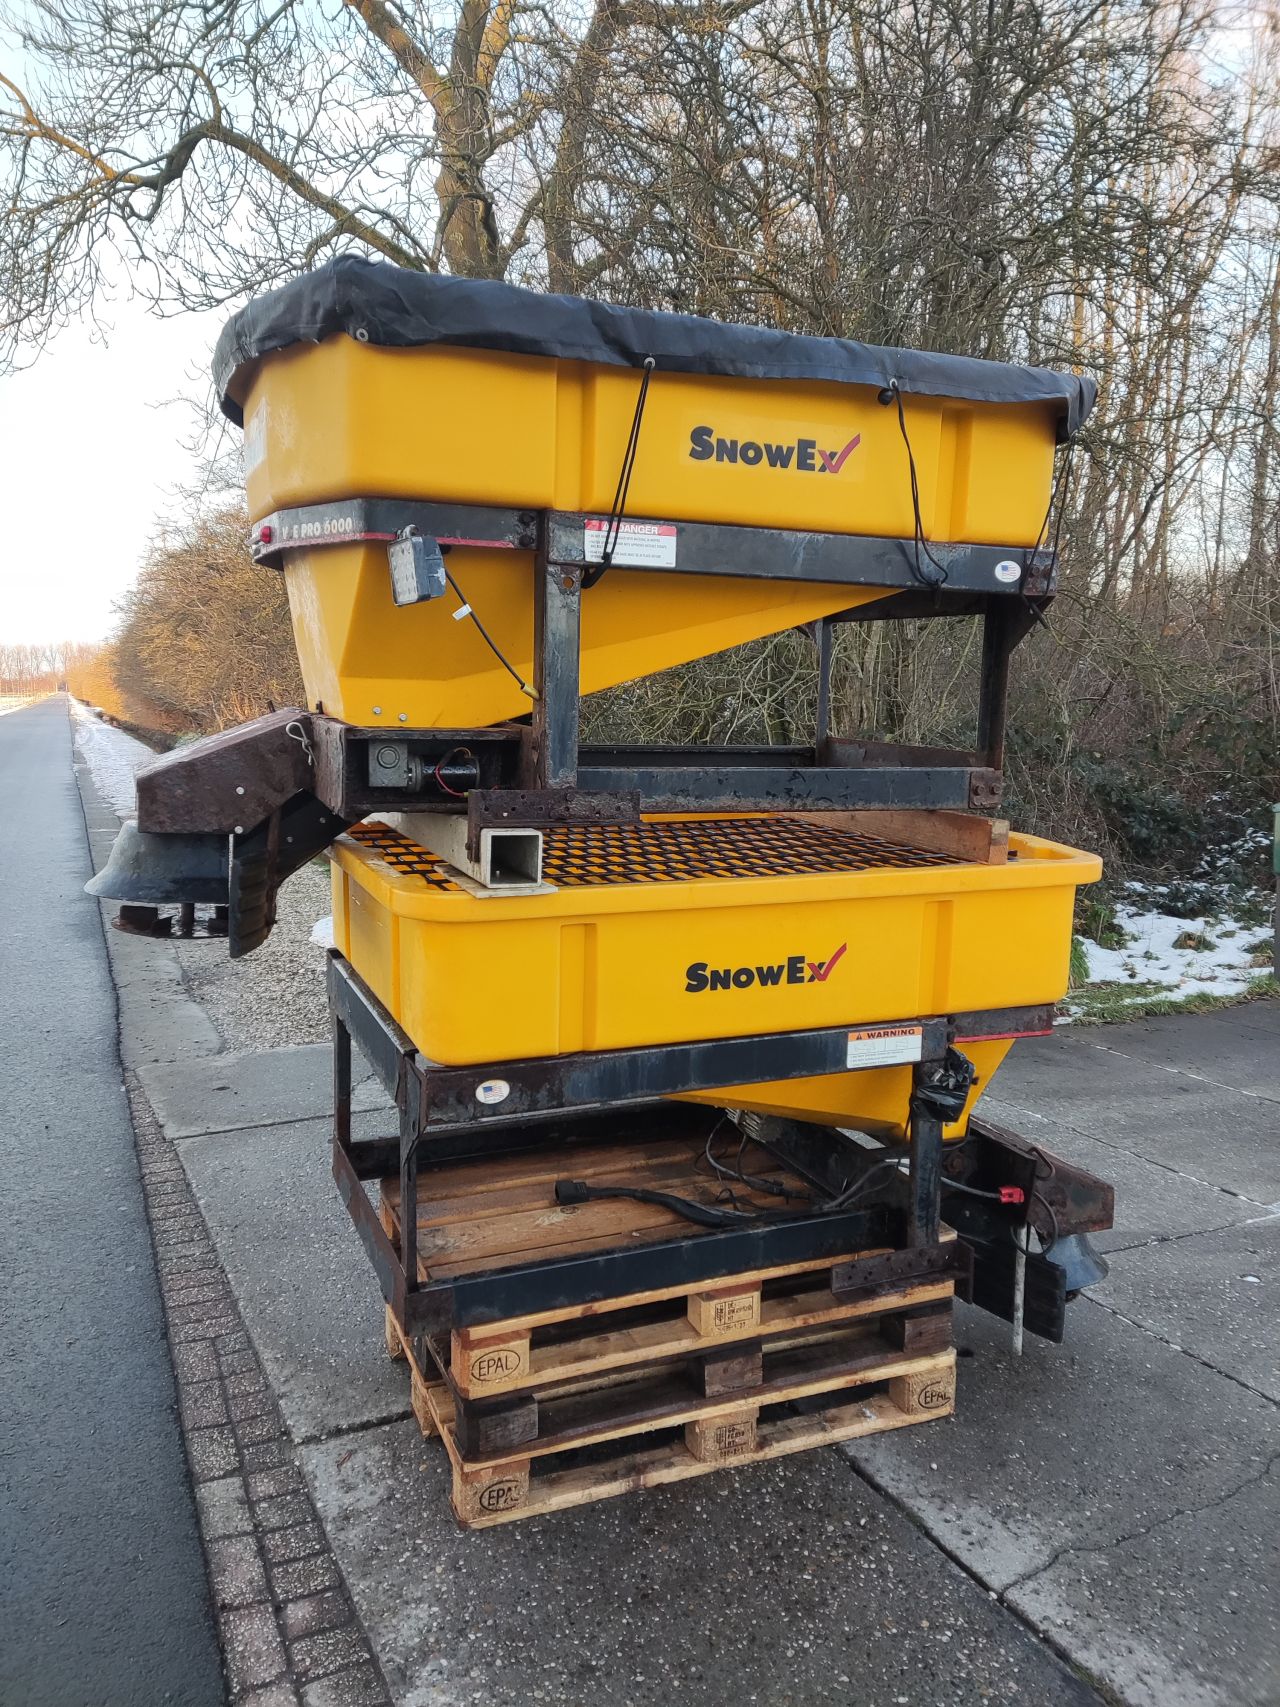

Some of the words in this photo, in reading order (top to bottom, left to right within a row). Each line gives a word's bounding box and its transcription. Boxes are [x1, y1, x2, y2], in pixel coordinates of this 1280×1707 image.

[301, 521, 321, 538] PRO
[324, 517, 353, 535] 6000
[867, 1028, 915, 1039] WARNING
[478, 1355, 514, 1379] EPAL
[924, 1390, 950, 1405] EPAL
